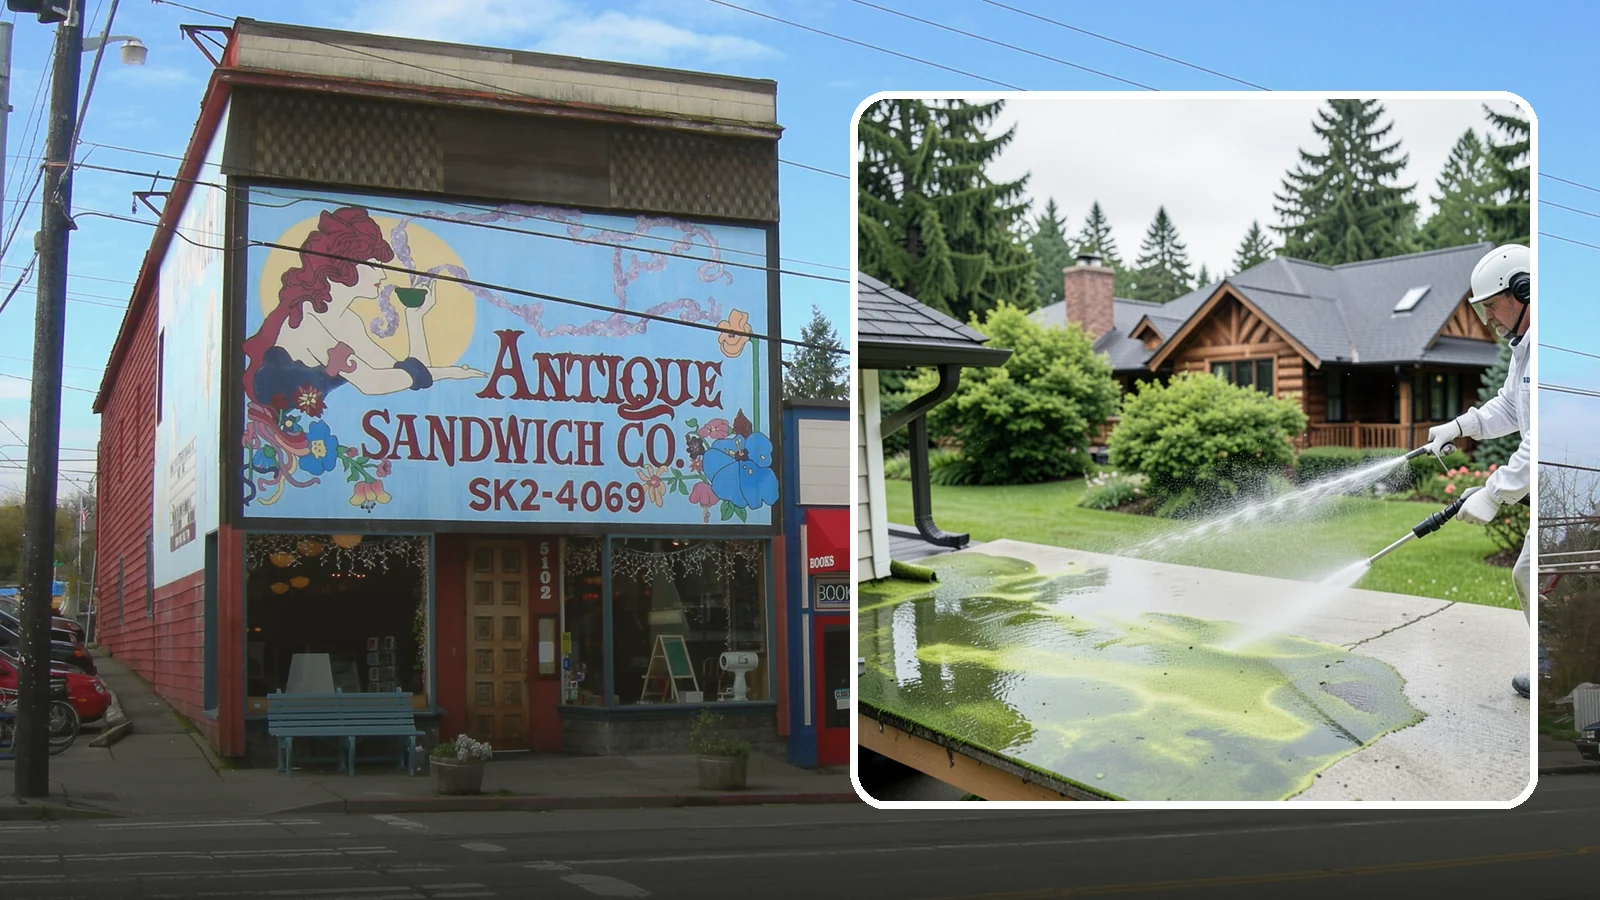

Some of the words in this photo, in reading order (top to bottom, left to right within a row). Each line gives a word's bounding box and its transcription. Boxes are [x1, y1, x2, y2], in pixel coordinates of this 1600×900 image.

[476, 329, 723, 420] ANTIQUE
[361, 408, 604, 467] SANDWICH
[617, 422, 684, 468] CO.
[468, 477, 646, 513] SK2-4069
[540, 541, 551, 599] 5102
[809, 555, 835, 569] BOOKS
